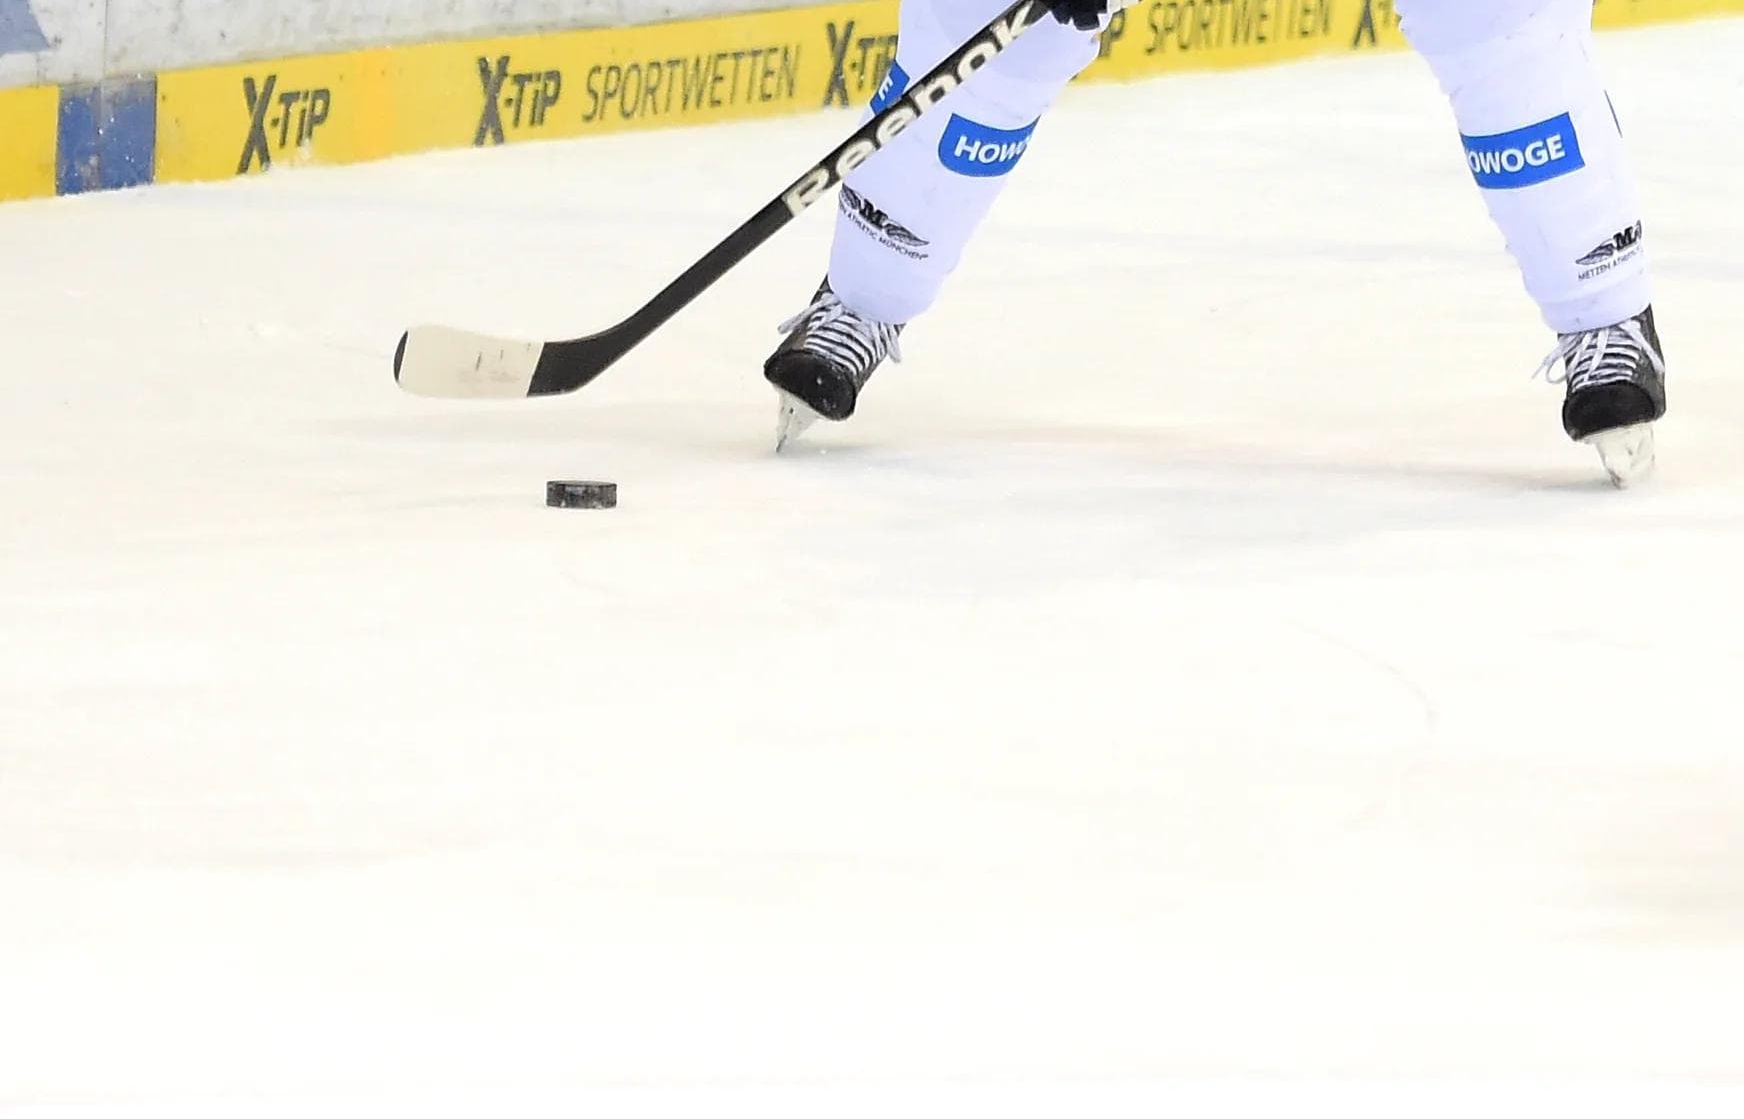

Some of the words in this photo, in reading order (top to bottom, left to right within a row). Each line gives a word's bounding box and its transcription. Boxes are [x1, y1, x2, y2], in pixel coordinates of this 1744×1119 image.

[582, 44, 801, 123] SPORTWETTEN
[783, 0, 1034, 218] Reebok
[1467, 133, 1566, 175] OWOGE
